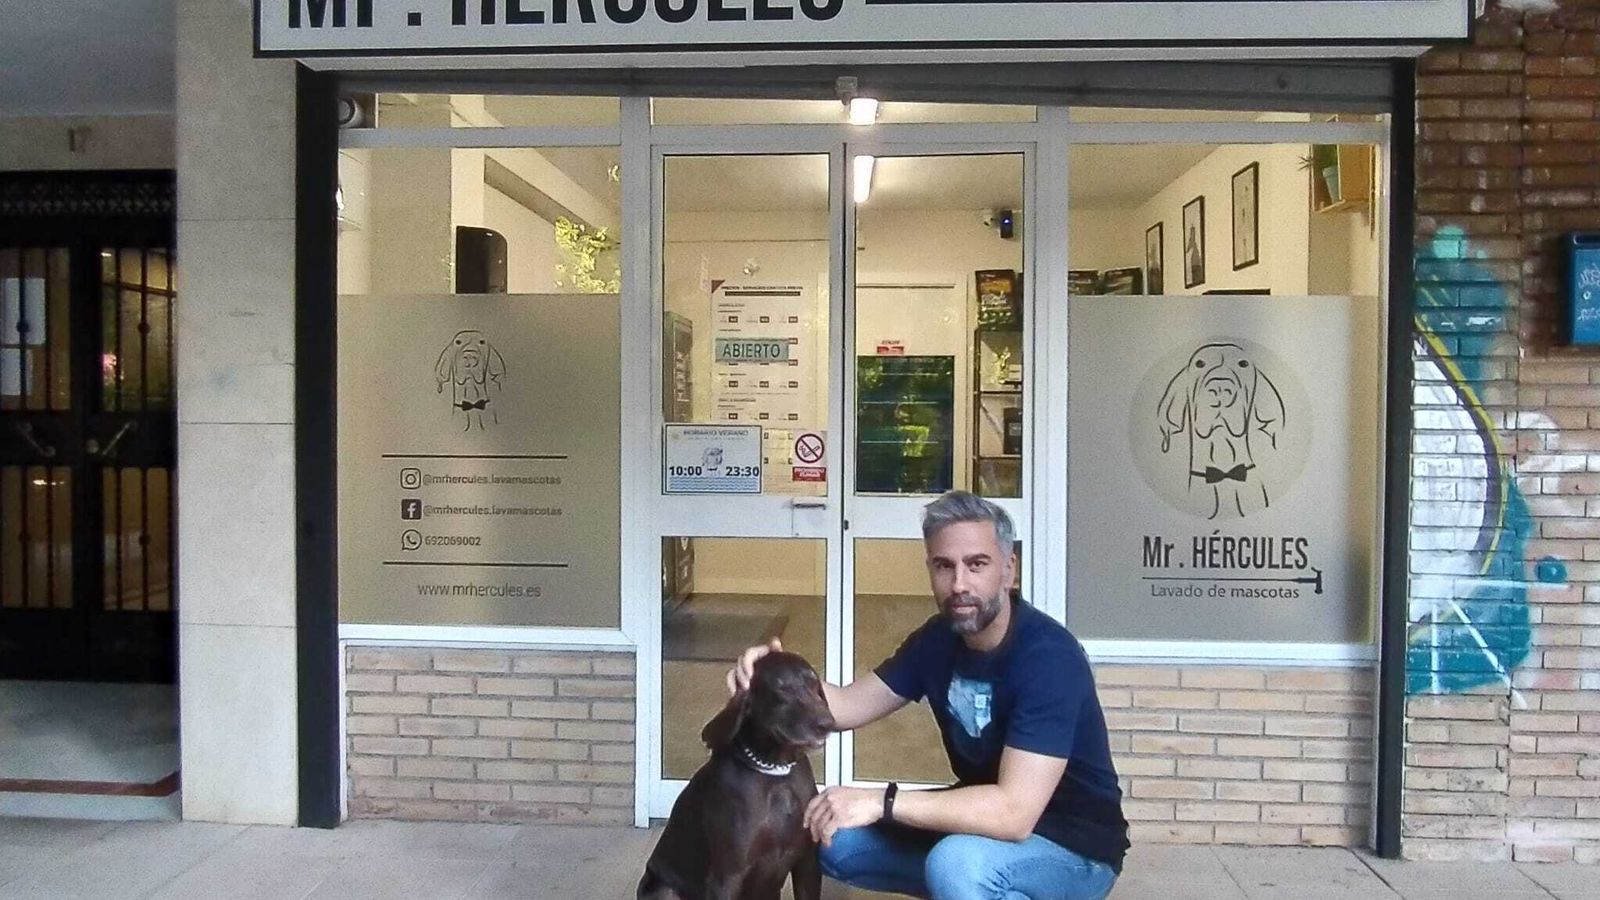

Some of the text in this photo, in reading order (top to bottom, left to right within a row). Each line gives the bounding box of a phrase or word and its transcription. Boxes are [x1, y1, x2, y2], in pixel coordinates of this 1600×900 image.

[722, 343, 781, 358] ABIERTO
[669, 466, 760, 477] 10:00 23:30
[422, 474, 562, 486] @mrhercules.lavamascotas
[423, 504, 563, 516] @mrhercules.lavamascotas
[1192, 530, 1309, 569] HÉRCULES
[417, 582, 542, 597] www.mrhercules.es
[1151, 584, 1300, 599] Lavado de mascotas
